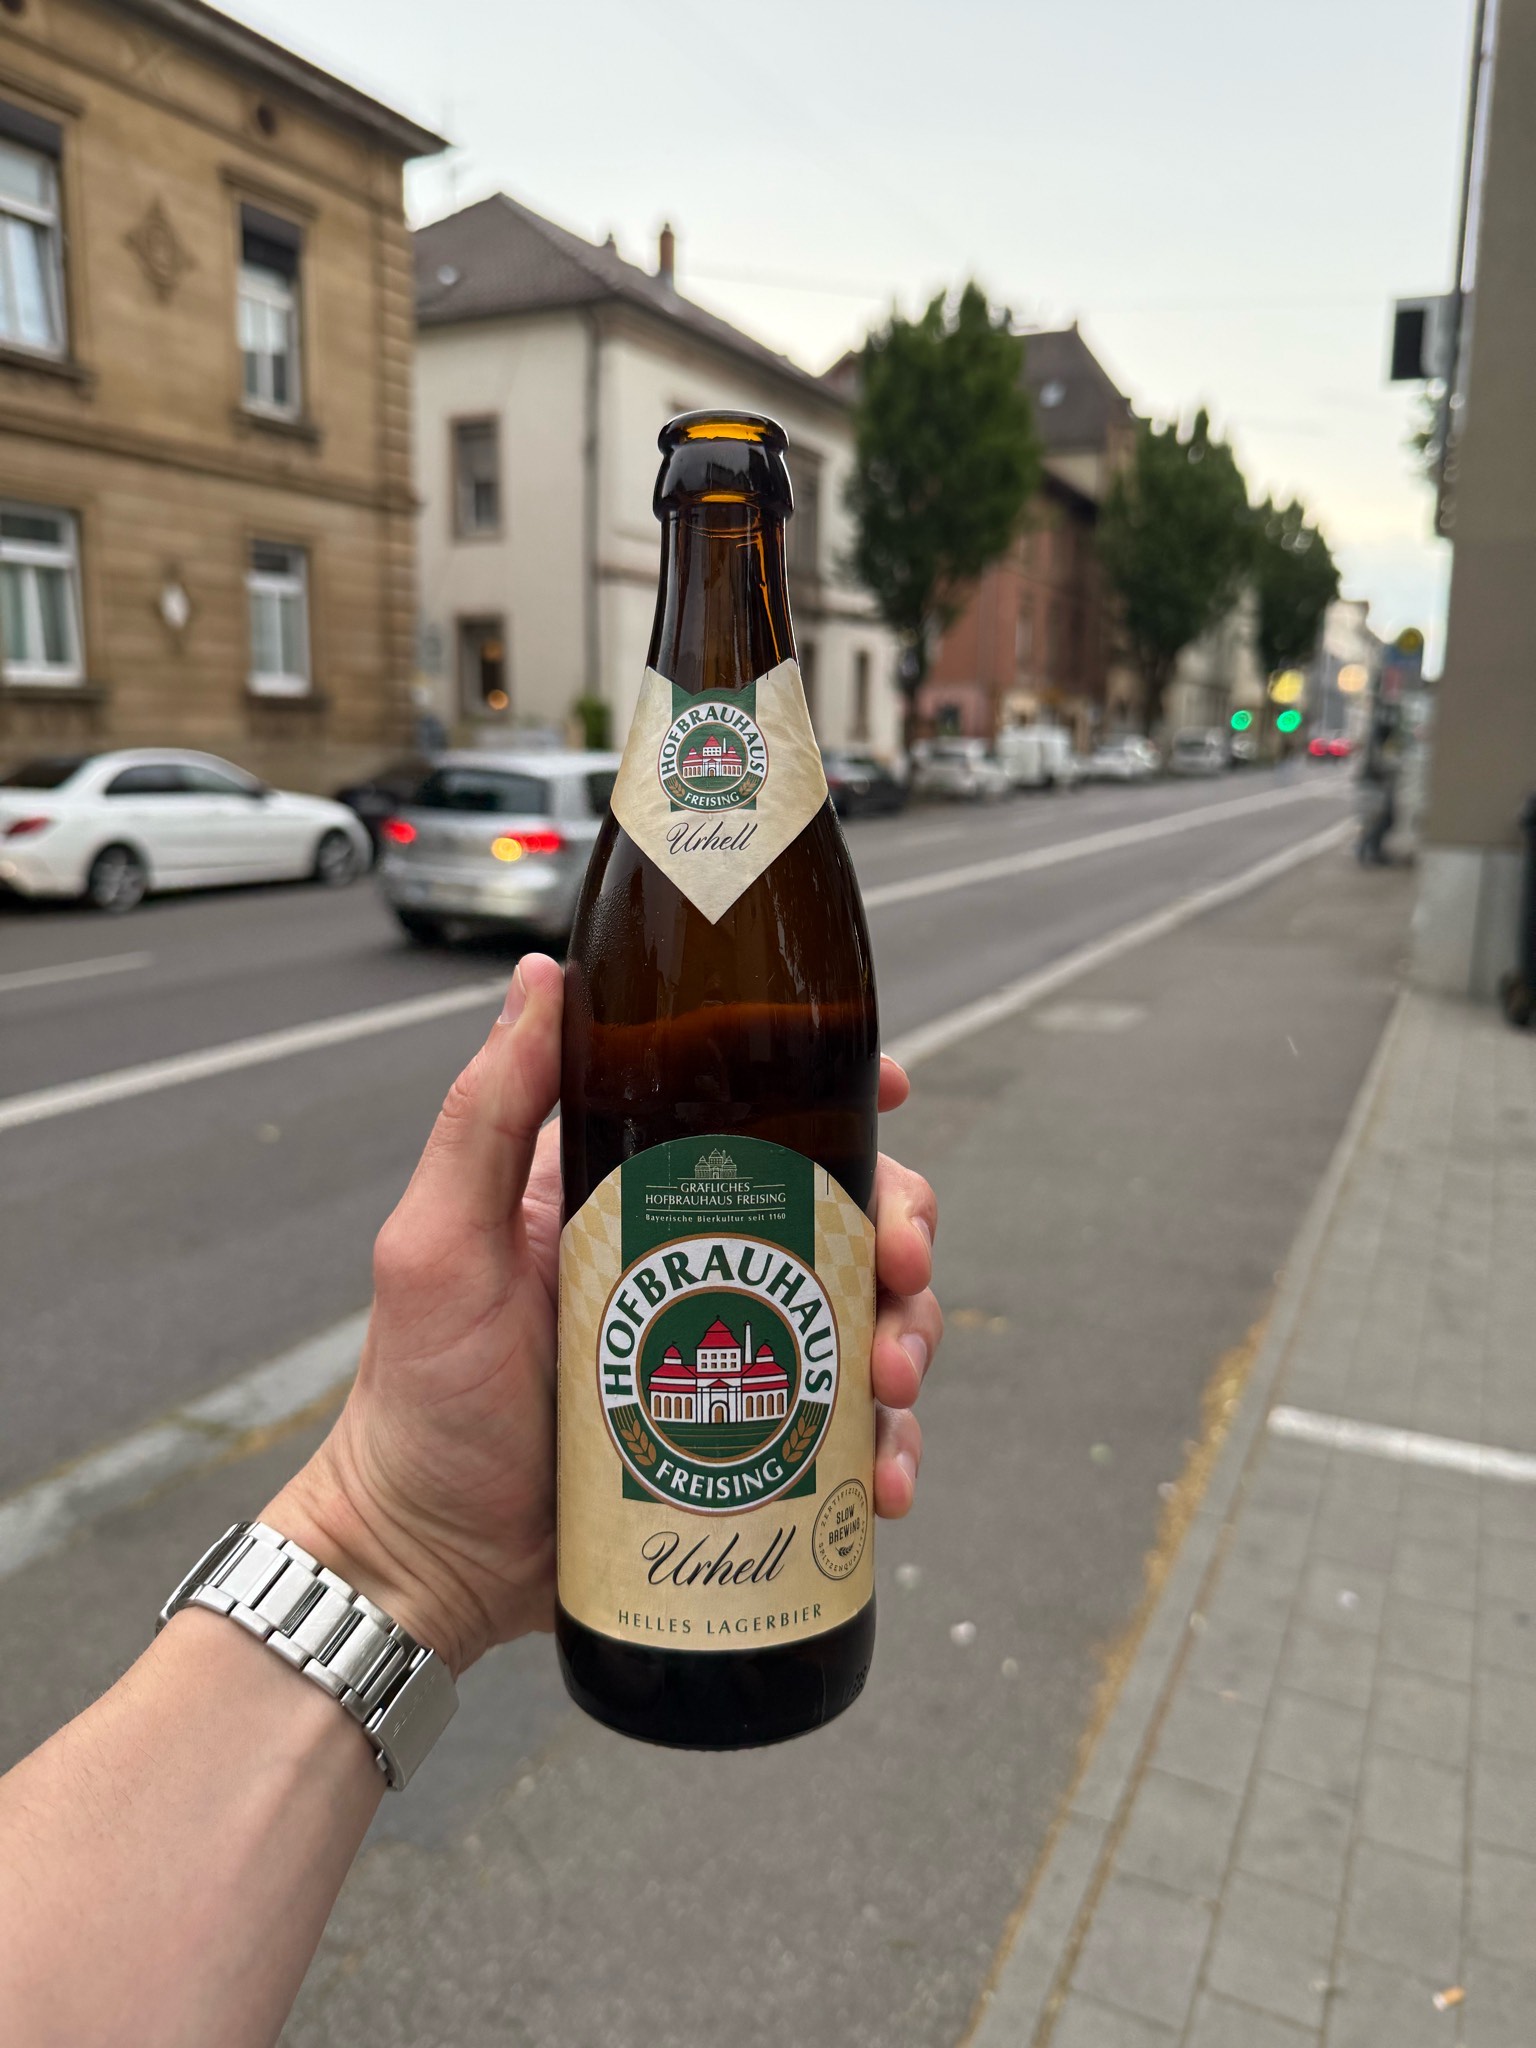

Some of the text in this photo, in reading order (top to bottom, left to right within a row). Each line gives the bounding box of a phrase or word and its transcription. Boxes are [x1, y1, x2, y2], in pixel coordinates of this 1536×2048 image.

[661, 705, 765, 775] HOFBRAUHAUS
[684, 791, 740, 807] FREISING
[666, 821, 758, 855] Urhell
[645, 1192, 786, 1206] HOFBRAUHAUS FREISING
[680, 1182, 751, 1193] GRÄFLICHES
[645, 1213, 786, 1223] Bayerische Bierkultur seit 1160
[603, 1244, 834, 1396] HOFBRAUHAUS
[655, 1457, 784, 1499] FREISING
[836, 1503, 855, 1525] SLOW
[828, 1516, 860, 1545] BREWING
[641, 1524, 797, 1586] Urhell
[618, 1603, 822, 1634] HELLES LAGERBIER
